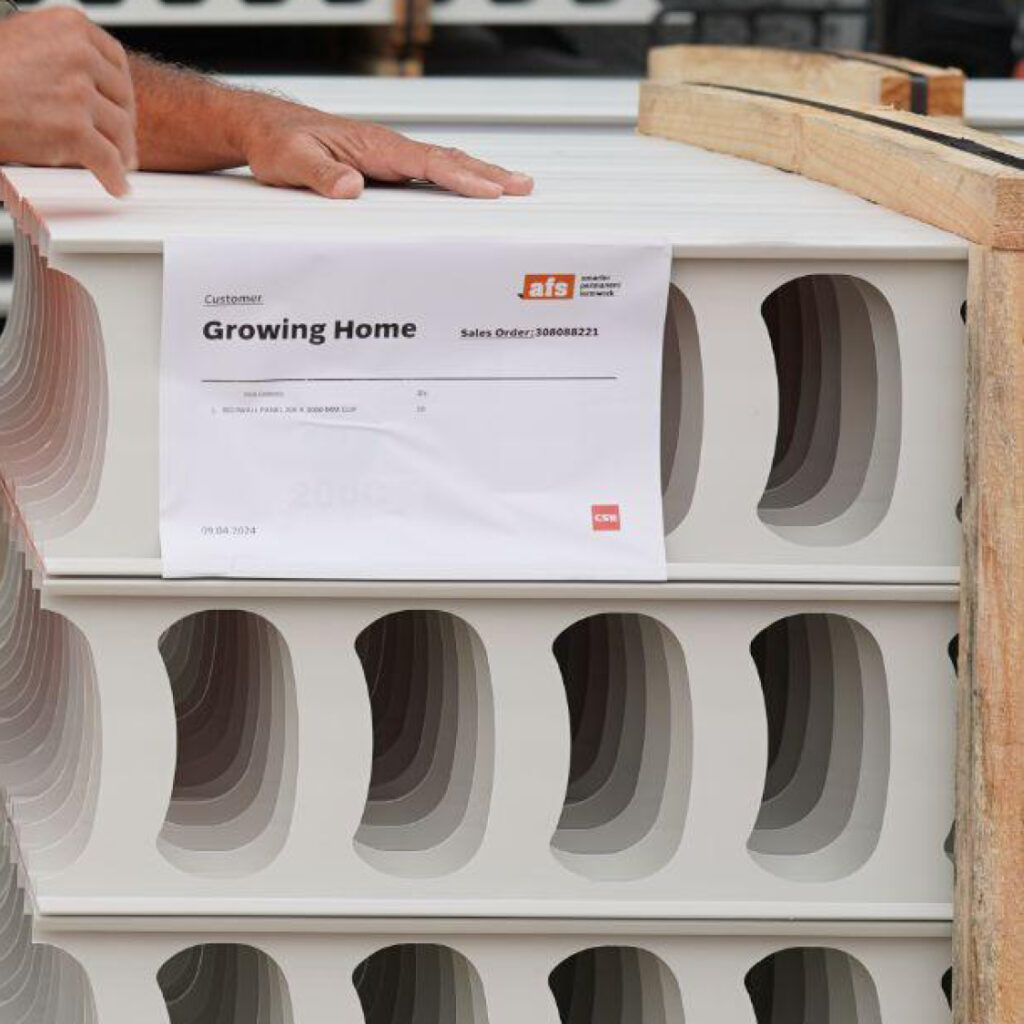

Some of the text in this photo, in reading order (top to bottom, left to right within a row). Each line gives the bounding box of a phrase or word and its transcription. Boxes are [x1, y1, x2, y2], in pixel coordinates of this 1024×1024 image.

[529, 276, 569, 298] afs
[204, 294, 263, 304] Customer
[202, 317, 417, 345] Growing Home
[460, 328, 492, 338] Sales
